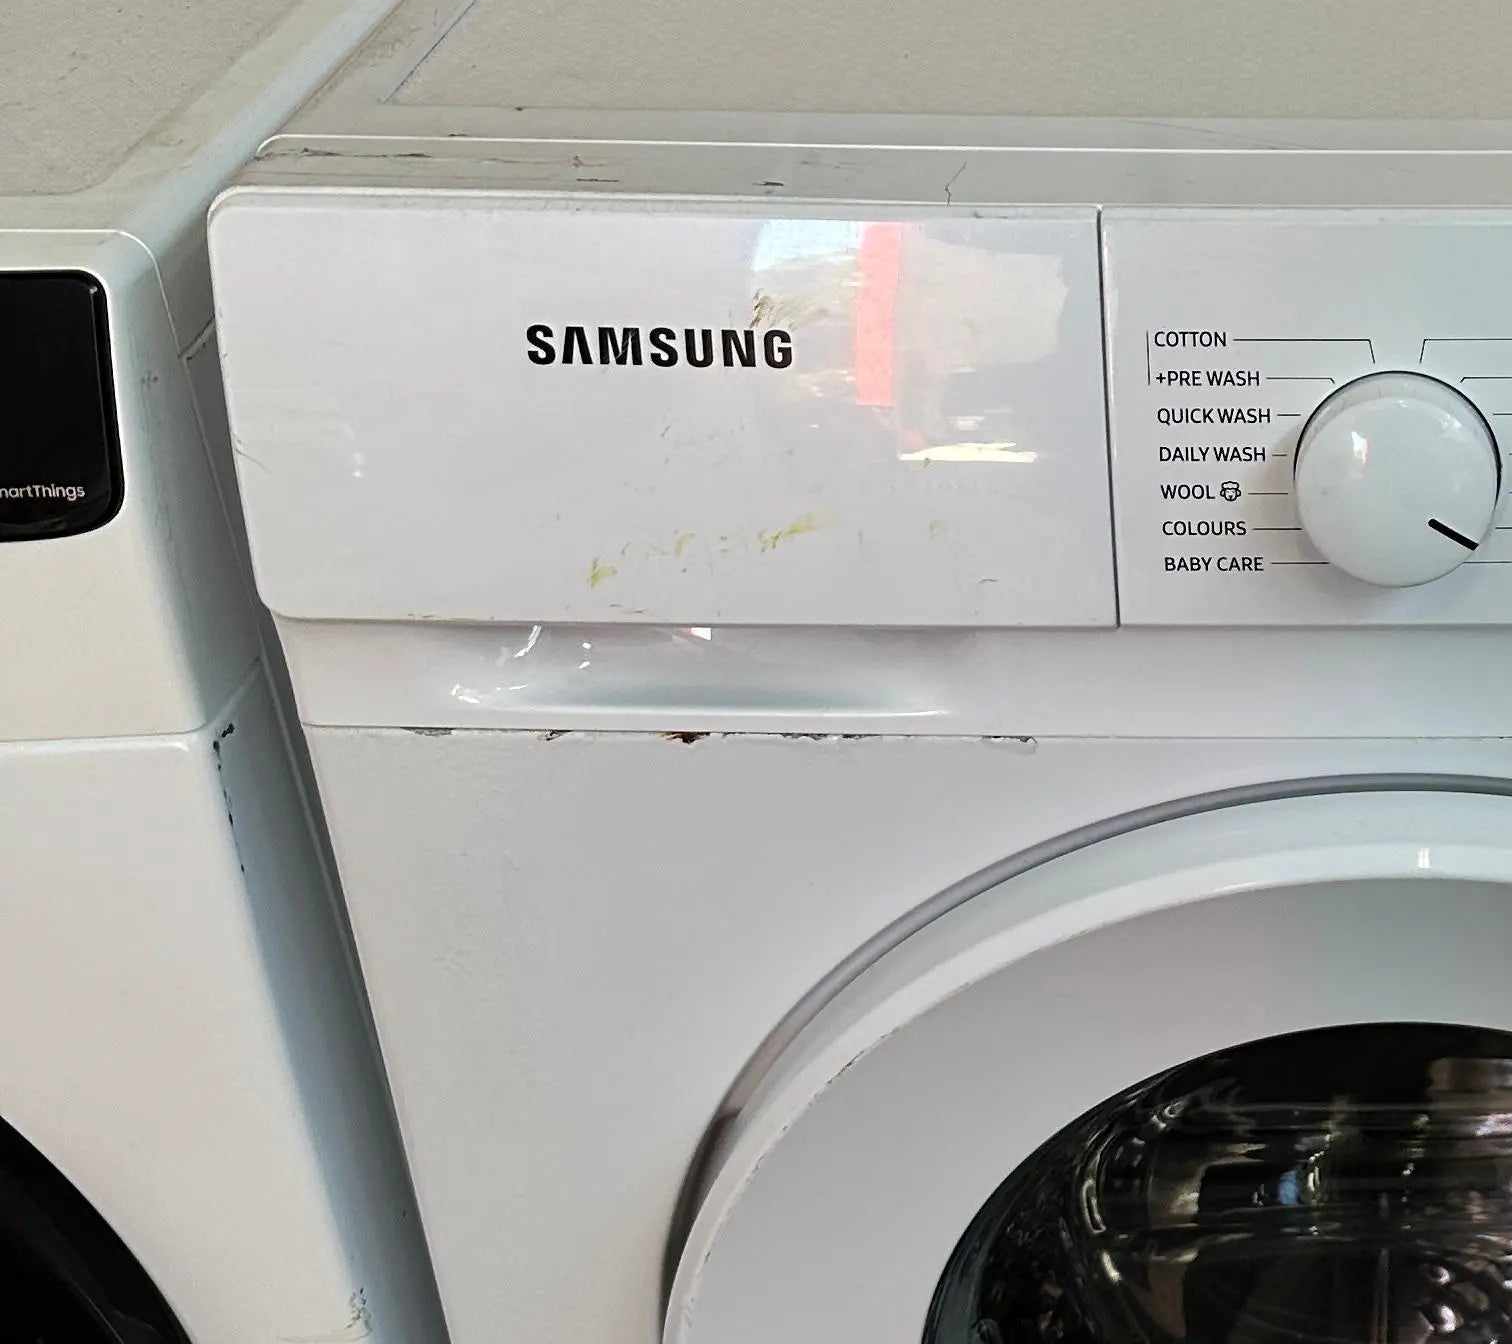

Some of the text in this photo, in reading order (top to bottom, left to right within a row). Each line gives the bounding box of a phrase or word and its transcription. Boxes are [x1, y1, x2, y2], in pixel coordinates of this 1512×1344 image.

[527, 324, 793, 368] SAMSUNG
[1155, 331, 1226, 347] COTTON
[1156, 371, 1259, 386] +PRE WASH
[1158, 408, 1270, 426] QUICK WASH
[1160, 447, 1265, 462] DAILY WASH
[1161, 485, 1215, 499] WOOL
[1163, 521, 1246, 535] COLOURS
[1165, 557, 1264, 571] BABY CARE
